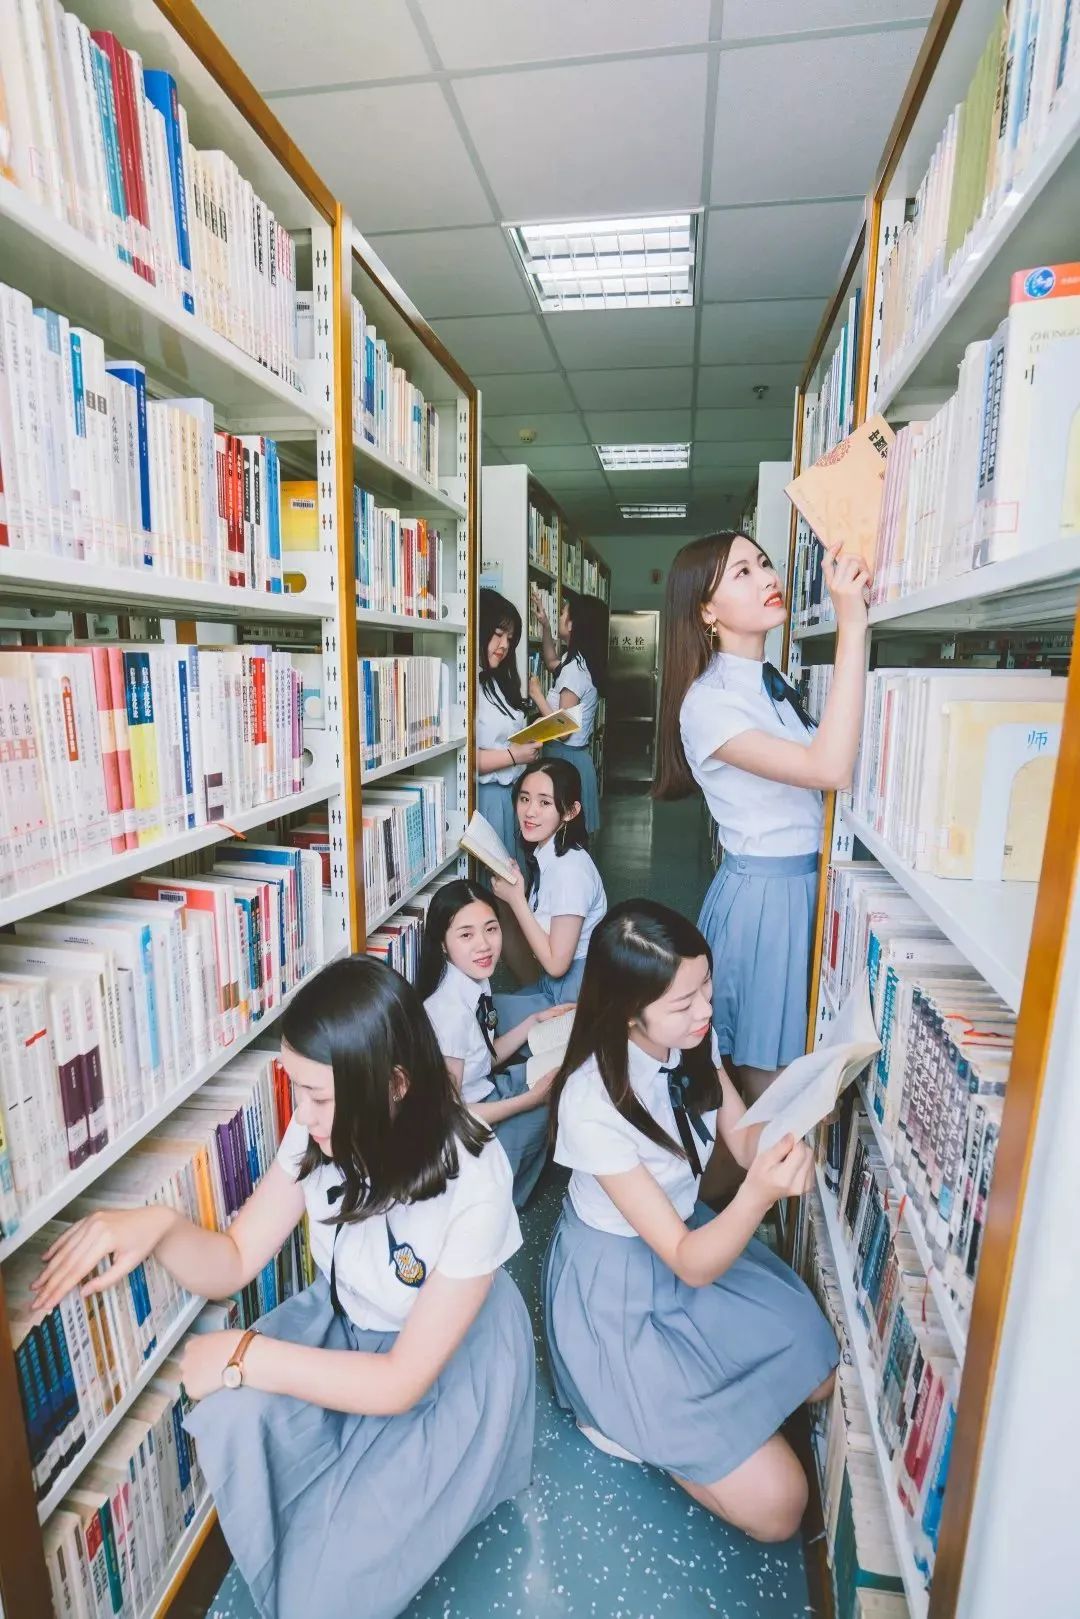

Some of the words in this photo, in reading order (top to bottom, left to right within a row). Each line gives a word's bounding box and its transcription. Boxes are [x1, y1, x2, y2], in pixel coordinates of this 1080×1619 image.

[609, 636, 645, 646] 消火栓
[1027, 729, 1048, 751] 师
